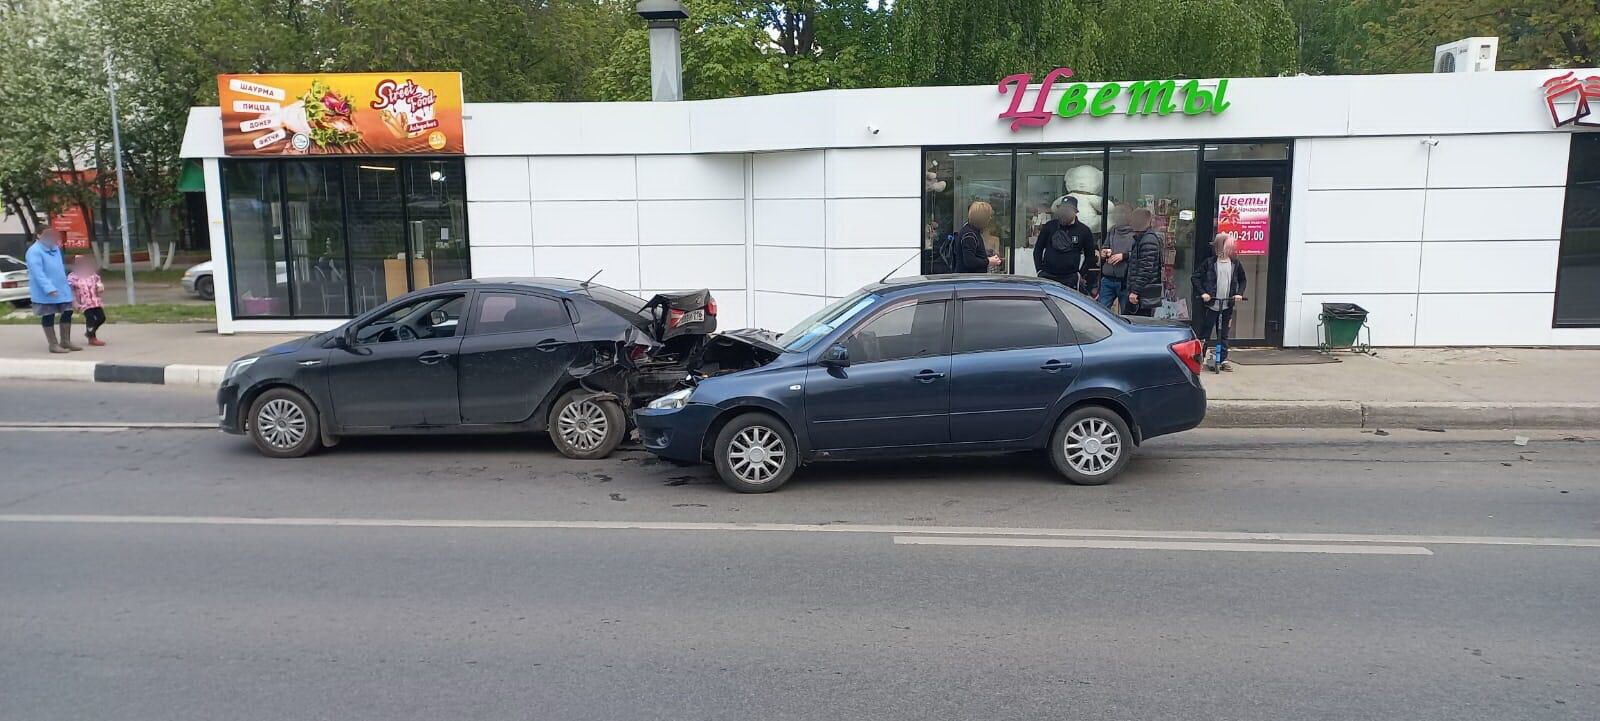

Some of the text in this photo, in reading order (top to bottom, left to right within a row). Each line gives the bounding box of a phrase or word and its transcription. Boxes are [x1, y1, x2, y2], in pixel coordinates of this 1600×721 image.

[240, 83, 274, 96] ШАУРМА
[371, 79, 418, 109] Street
[407, 88, 437, 112] Food
[998, 67, 1231, 132] Цветы
[243, 103, 271, 111] ПИЦЦА
[249, 119, 272, 129] ДОНЕР
[1220, 196, 1268, 207] Цветы
